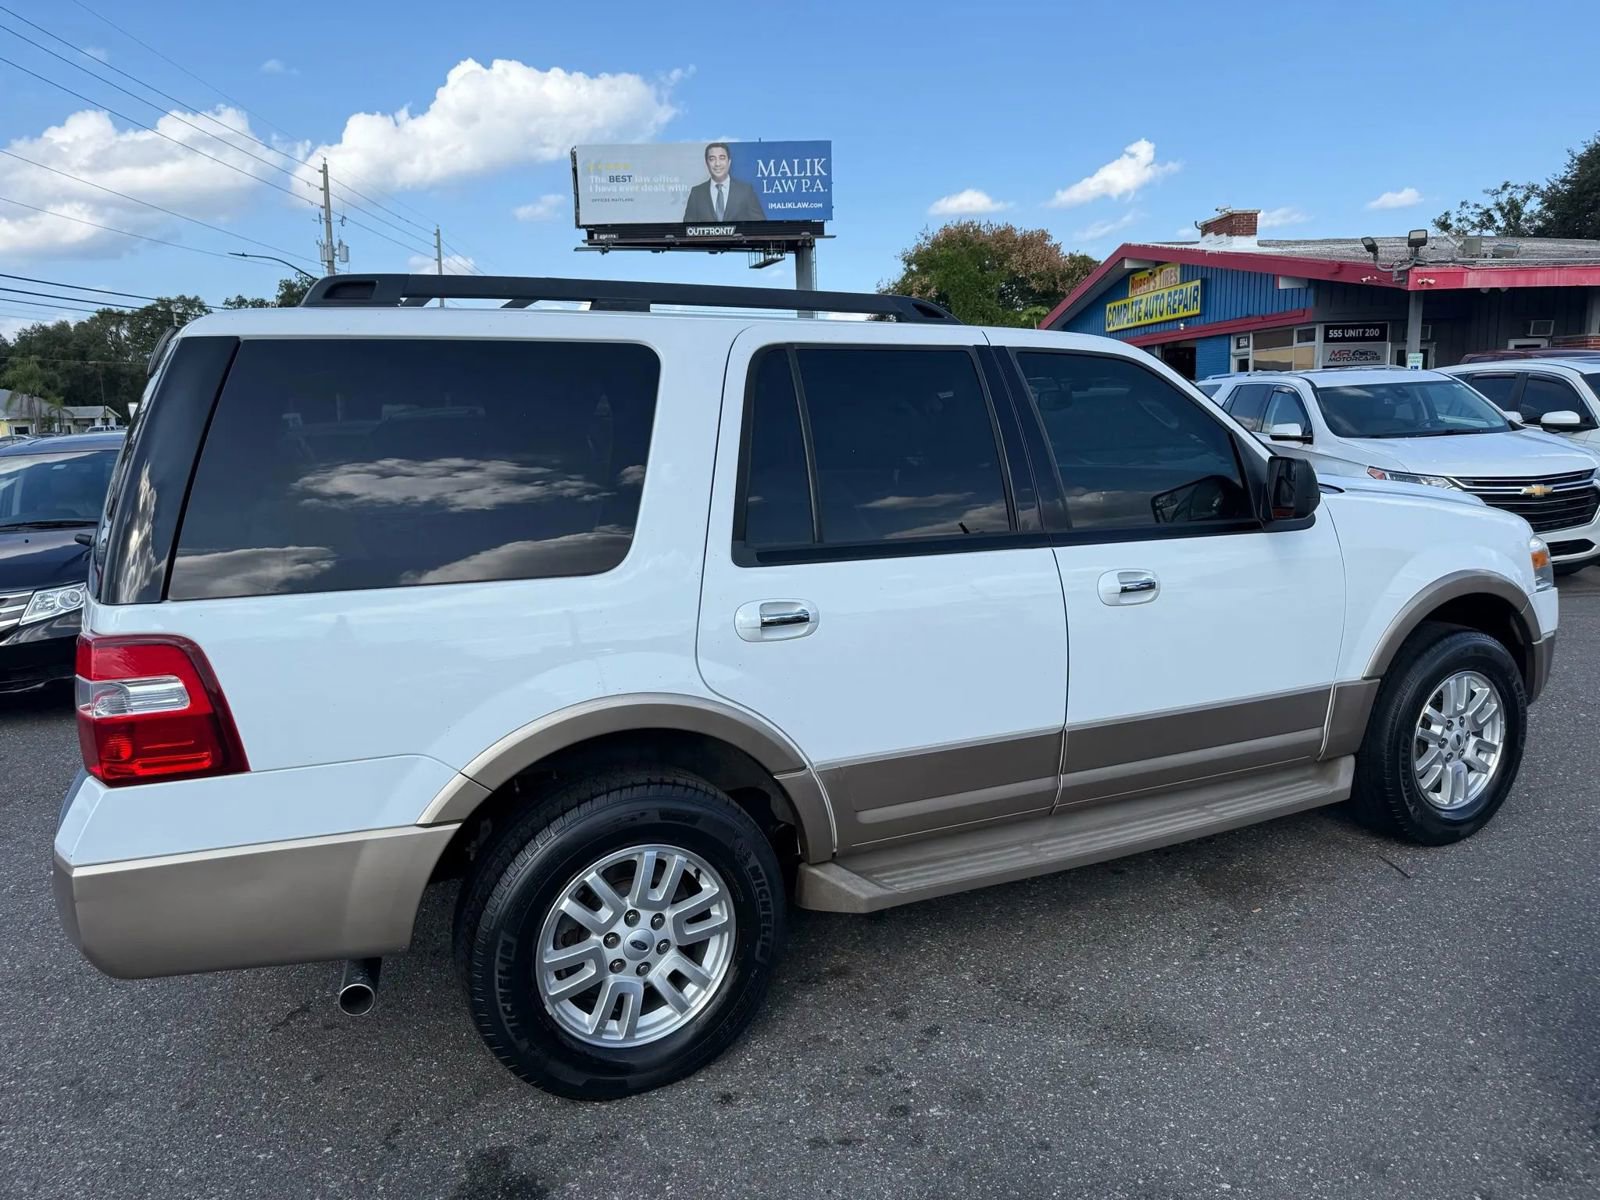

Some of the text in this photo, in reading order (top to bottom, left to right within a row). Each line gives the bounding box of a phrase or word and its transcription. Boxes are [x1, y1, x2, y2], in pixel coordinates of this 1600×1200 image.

[756, 158, 827, 177] MALIK
[608, 175, 633, 183] BEST
[762, 179, 828, 194] LAW P.A.
[1159, 267, 1179, 288] TIRES
[1107, 285, 1199, 329] COMPLETE AUTO REPAIR
[1328, 328, 1380, 338] 555 UNIT 200
